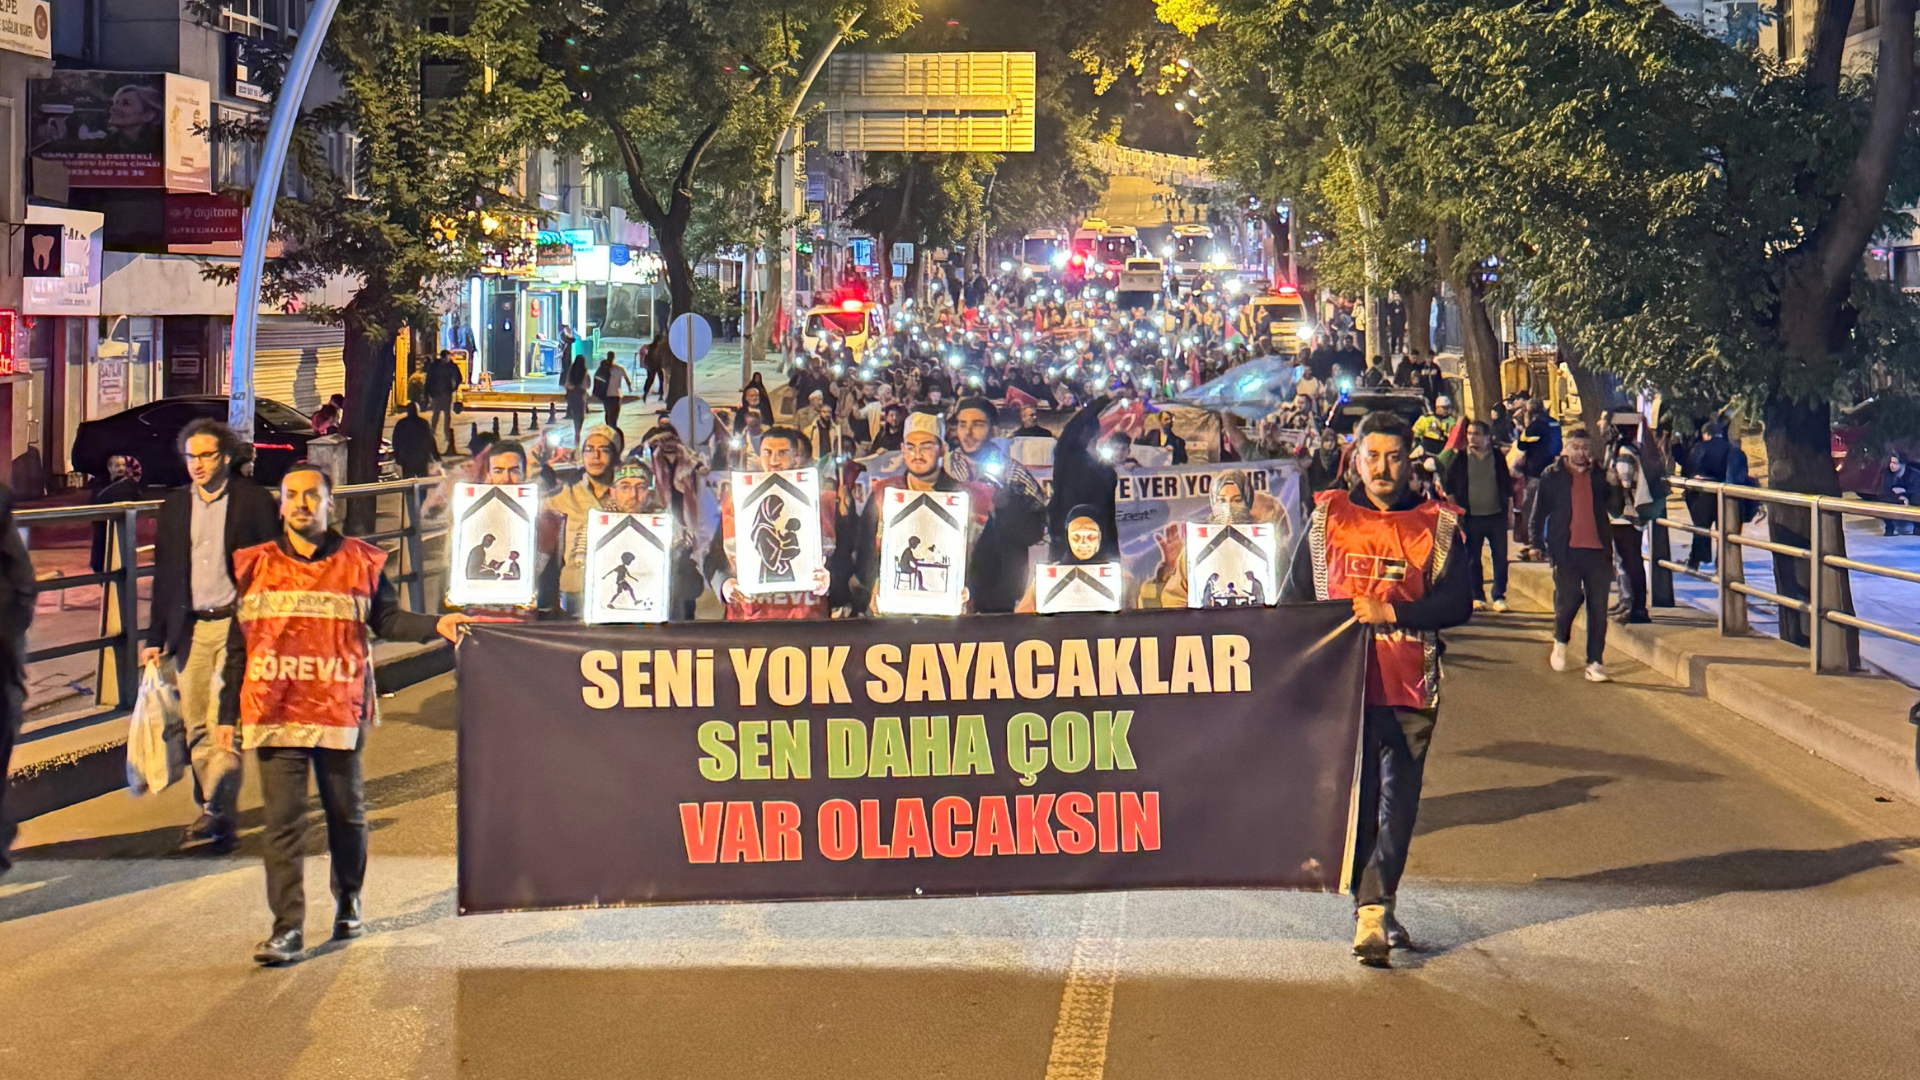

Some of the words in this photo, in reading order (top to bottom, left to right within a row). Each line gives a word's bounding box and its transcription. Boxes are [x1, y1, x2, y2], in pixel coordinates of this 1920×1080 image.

[193, 206, 238, 220] digitone
[1137, 476, 1178, 499] YER
[249, 649, 357, 683] GÖREVLİ
[728, 646, 852, 706] YOK
[865, 634, 1252, 704] SAYACAKLAR
[698, 719, 811, 782] SEN
[826, 715, 995, 779] DAHA
[1007, 710, 1138, 787] ÇOK
[679, 801, 803, 864] VAR
[817, 791, 1161, 861] OLACAKSIN
